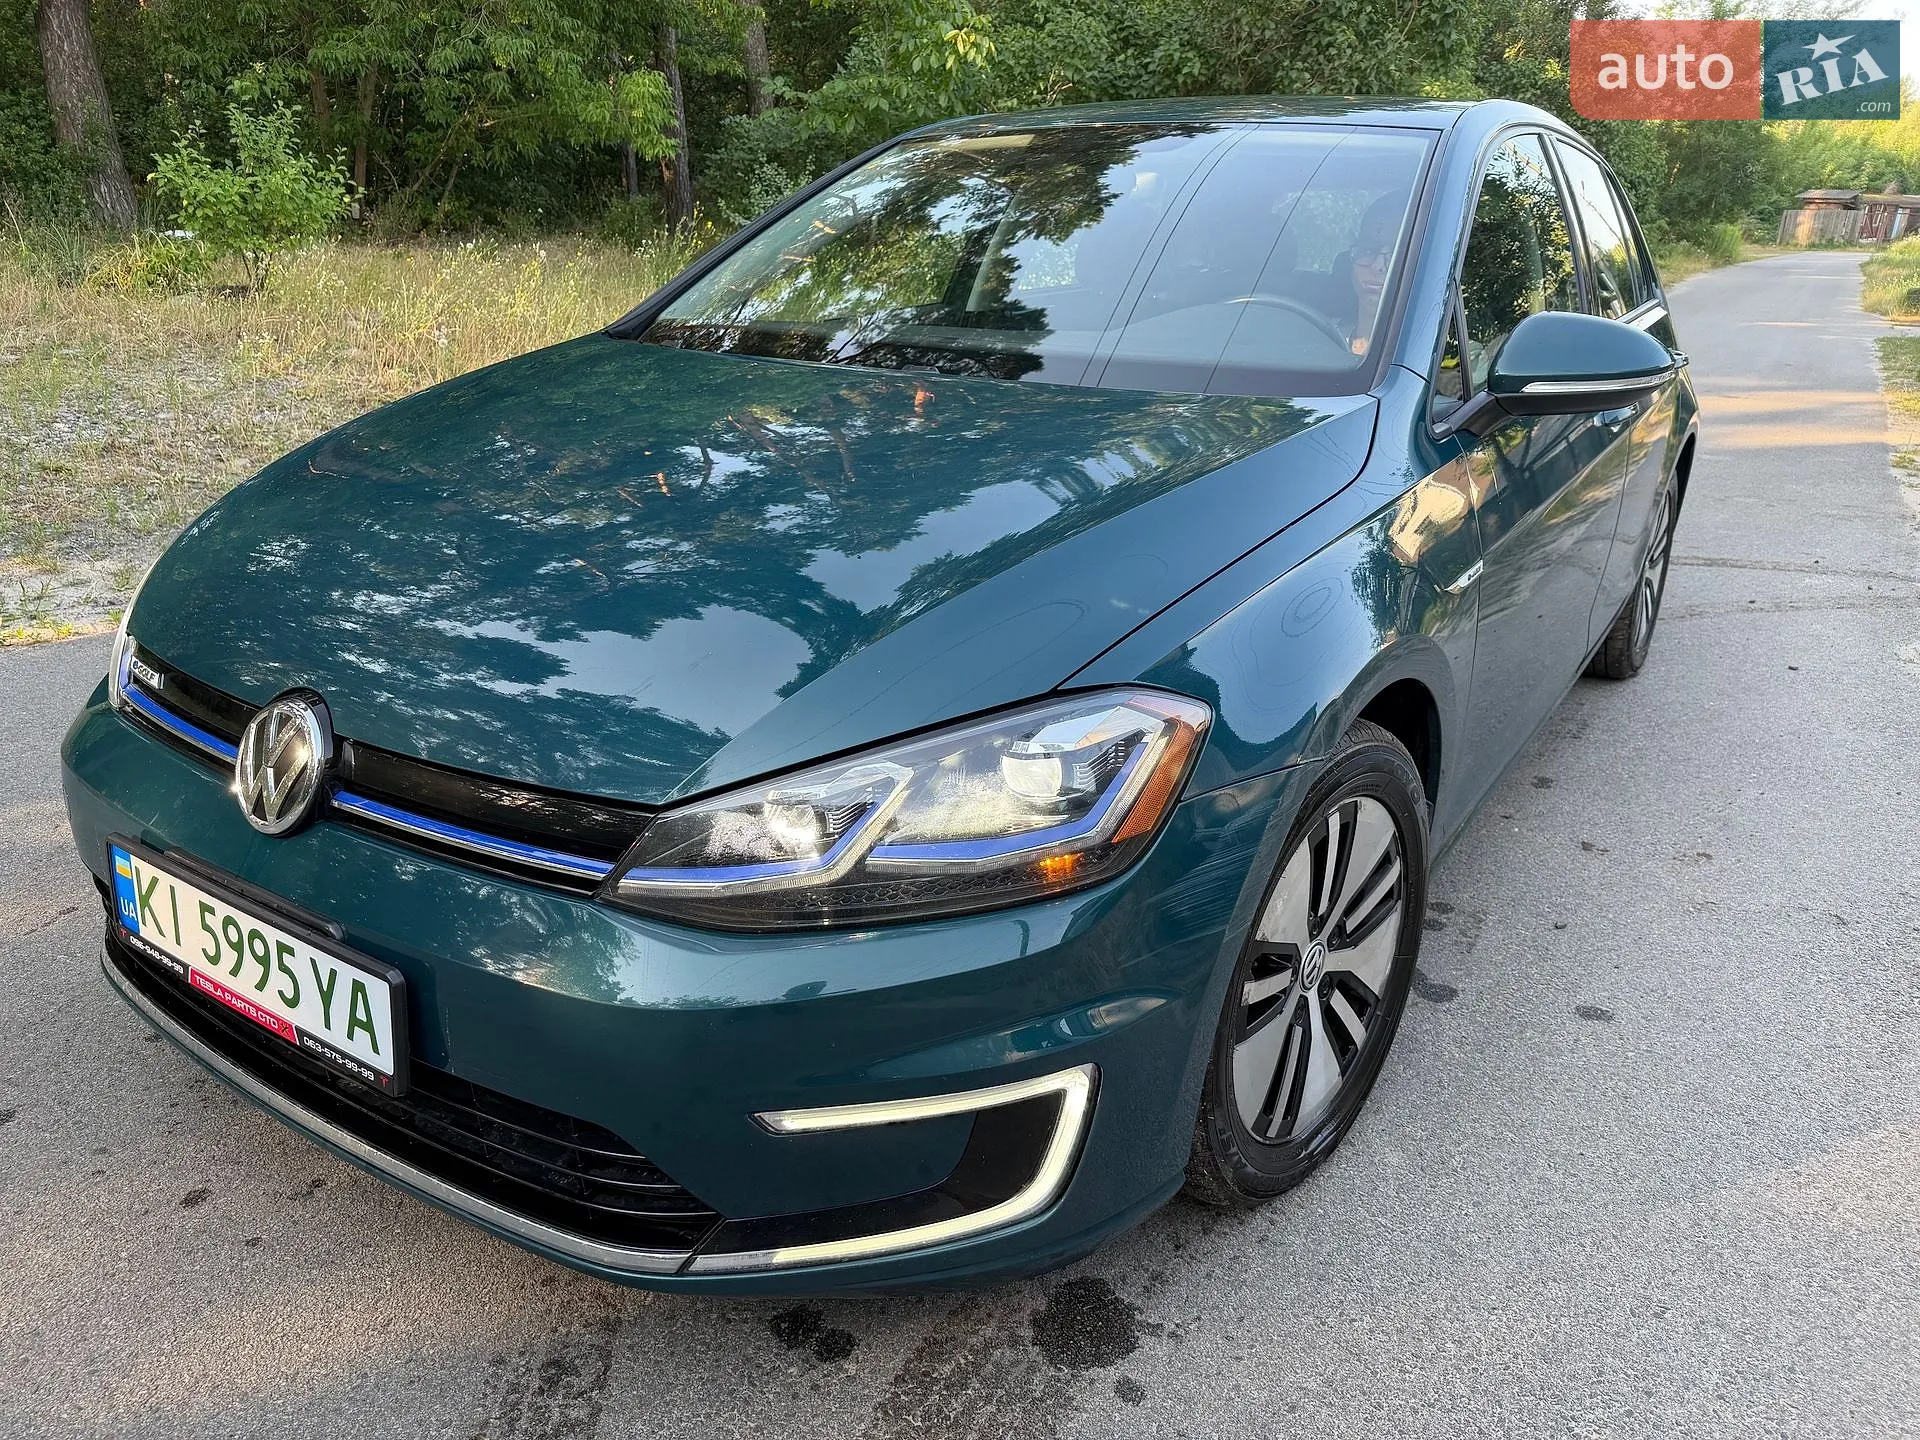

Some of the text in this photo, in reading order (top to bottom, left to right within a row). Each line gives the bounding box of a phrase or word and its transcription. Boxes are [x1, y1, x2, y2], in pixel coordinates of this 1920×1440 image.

[120, 896, 137, 918] UA
[134, 865, 380, 1056] KI 5995 YA
[194, 974, 224, 998] TESLA
[224, 994, 257, 1017] PARTS
[303, 1036, 375, 1081] 063-575-99-99
